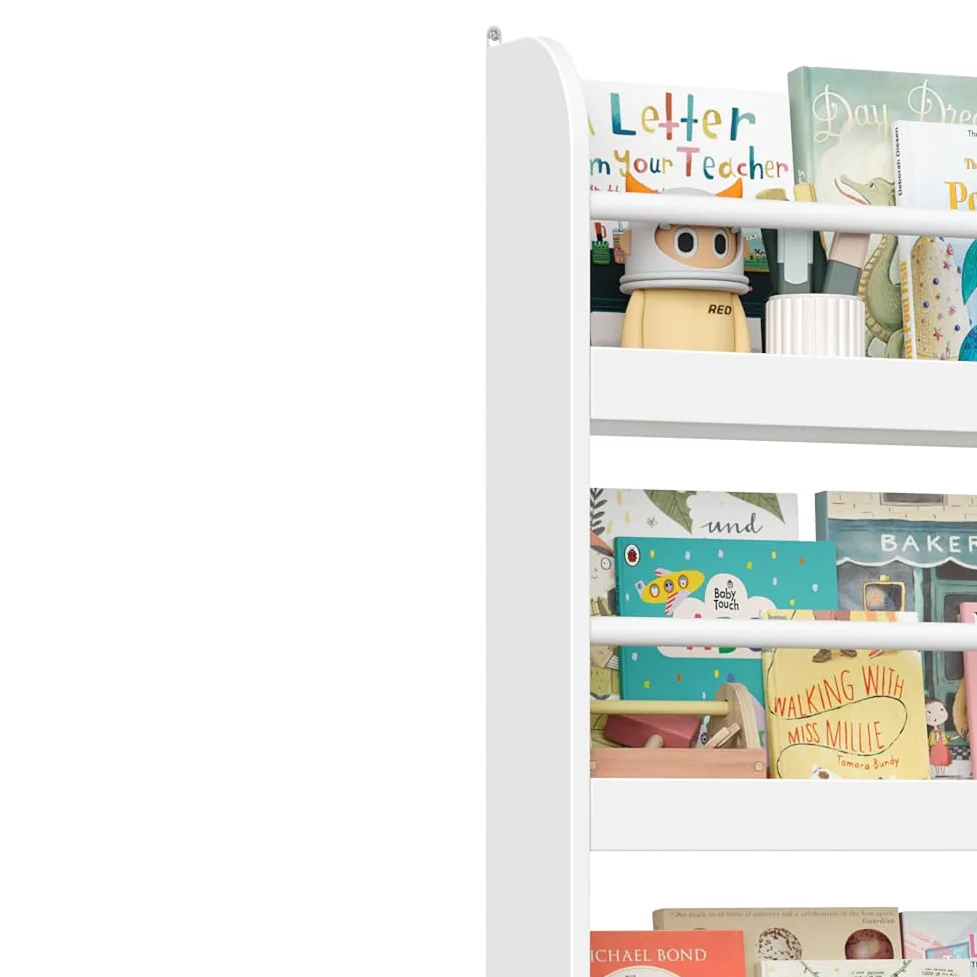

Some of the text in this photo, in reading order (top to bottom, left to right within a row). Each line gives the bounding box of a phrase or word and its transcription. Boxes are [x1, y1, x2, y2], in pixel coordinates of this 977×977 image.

[610, 91, 756, 142] Letter
[812, 83, 889, 143] Day
[613, 149, 674, 178] your
[676, 145, 789, 180] Teacher
[708, 304, 732, 315] RED
[700, 512, 764, 534] und
[713, 599, 740, 612] Touch
[714, 587, 737, 602] Baby
[774, 664, 905, 718] WALKING WITH
[788, 720, 885, 754] MISS MILLIE
[836, 755, 900, 770] Tamara Bundy
[590, 947, 707, 963] ICHAEL BOND
